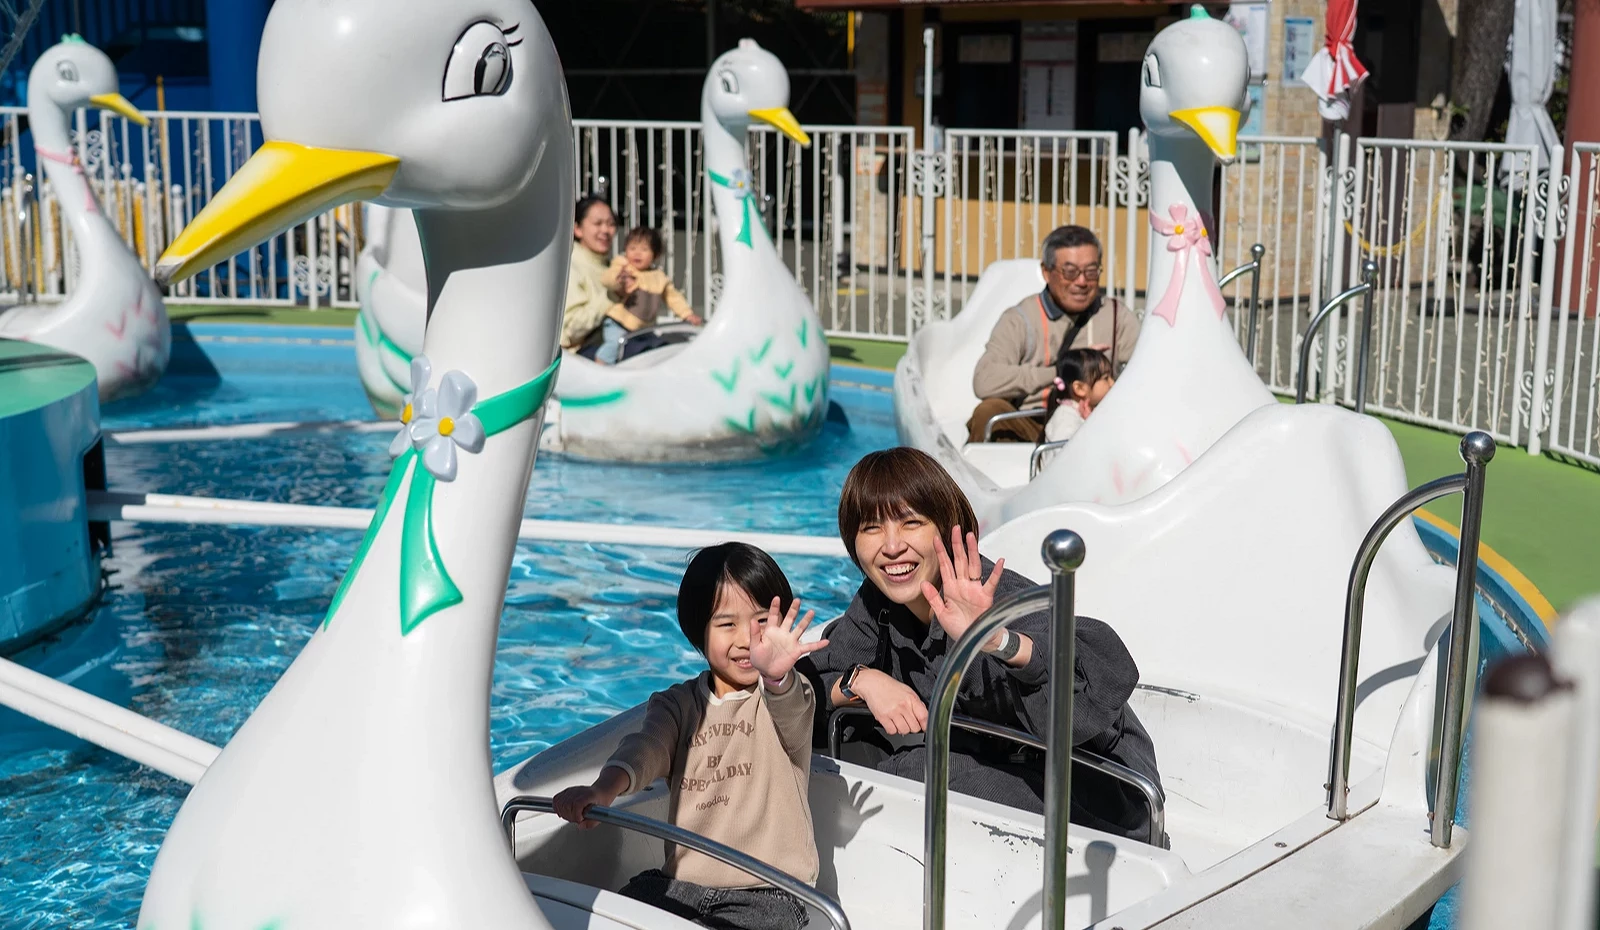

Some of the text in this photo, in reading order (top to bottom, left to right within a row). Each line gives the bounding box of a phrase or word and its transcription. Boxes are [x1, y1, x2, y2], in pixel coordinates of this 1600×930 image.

[680, 763, 752, 792] SPEL DAY
[695, 794, 730, 811] nooday
